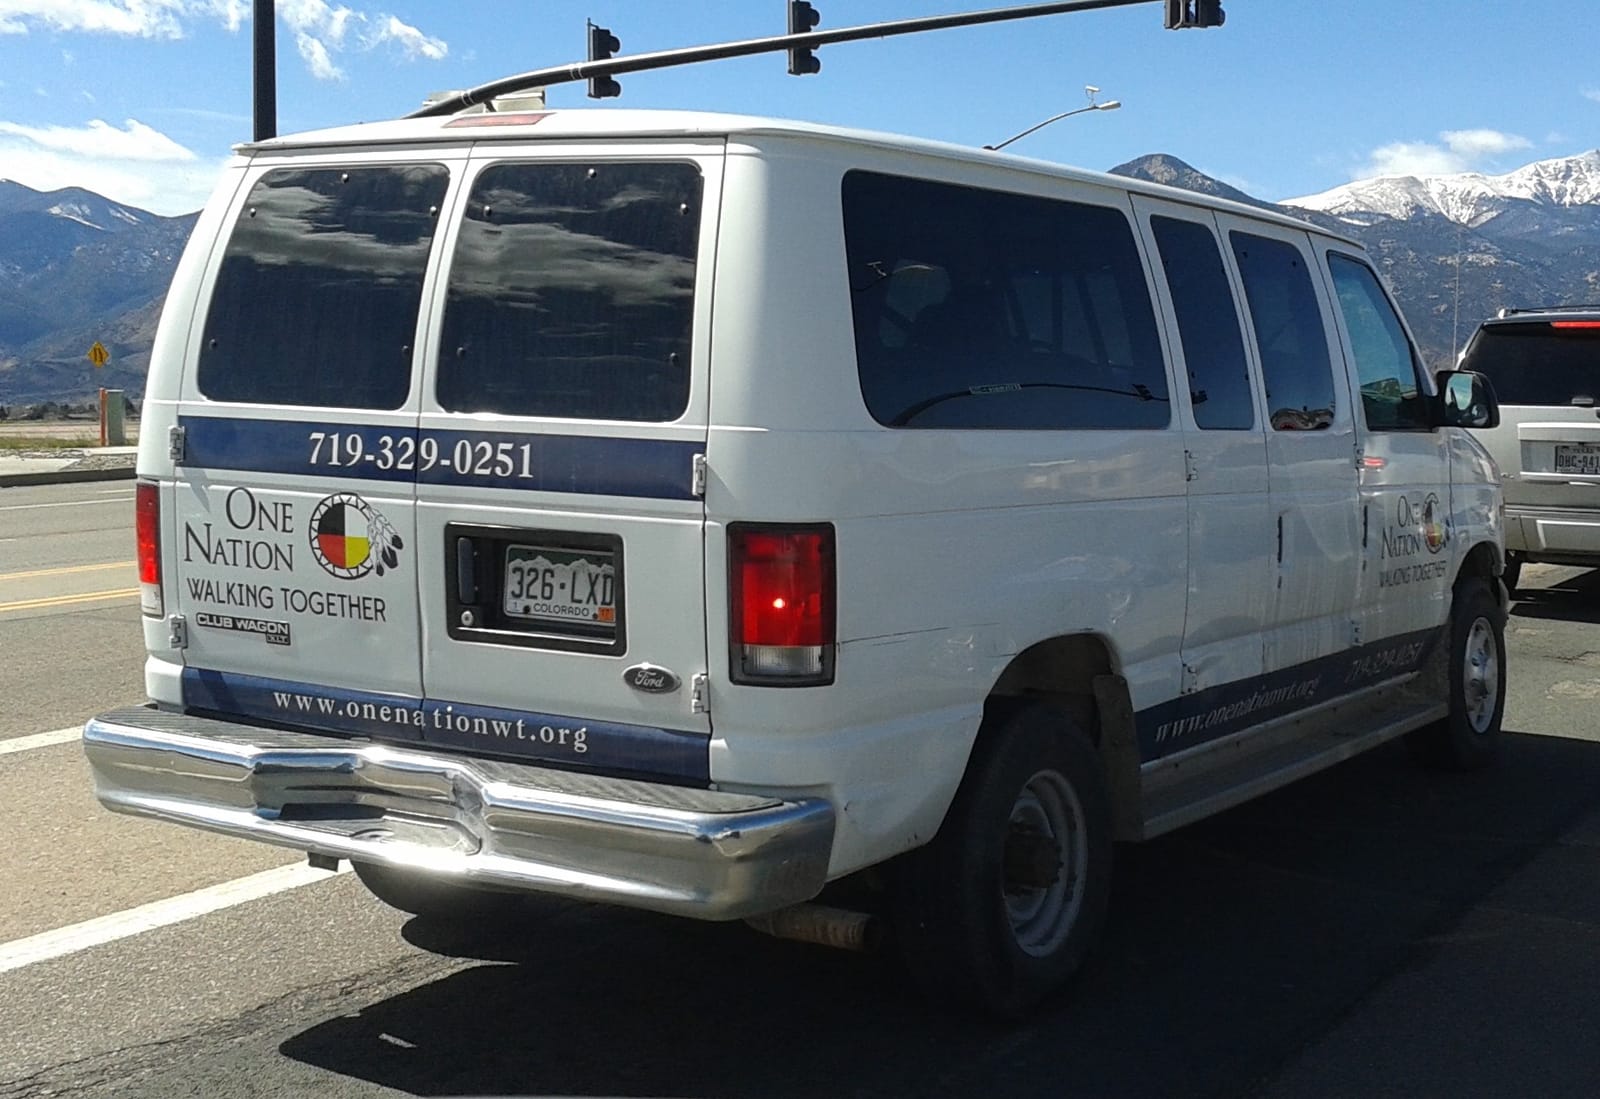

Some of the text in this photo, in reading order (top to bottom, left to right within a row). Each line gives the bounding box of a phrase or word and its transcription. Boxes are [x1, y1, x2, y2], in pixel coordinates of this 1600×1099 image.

[309, 432, 534, 478] 719-329-0251
[226, 487, 294, 533] ONE
[184, 521, 294, 572] NATION
[186, 577, 386, 622] WALKING TOGETHER
[533, 602, 590, 617] COLORADO
[197, 614, 289, 634] CLUB WAGON
[634, 671, 665, 688] Ford
[274, 691, 588, 753] www.onenationwt.org
